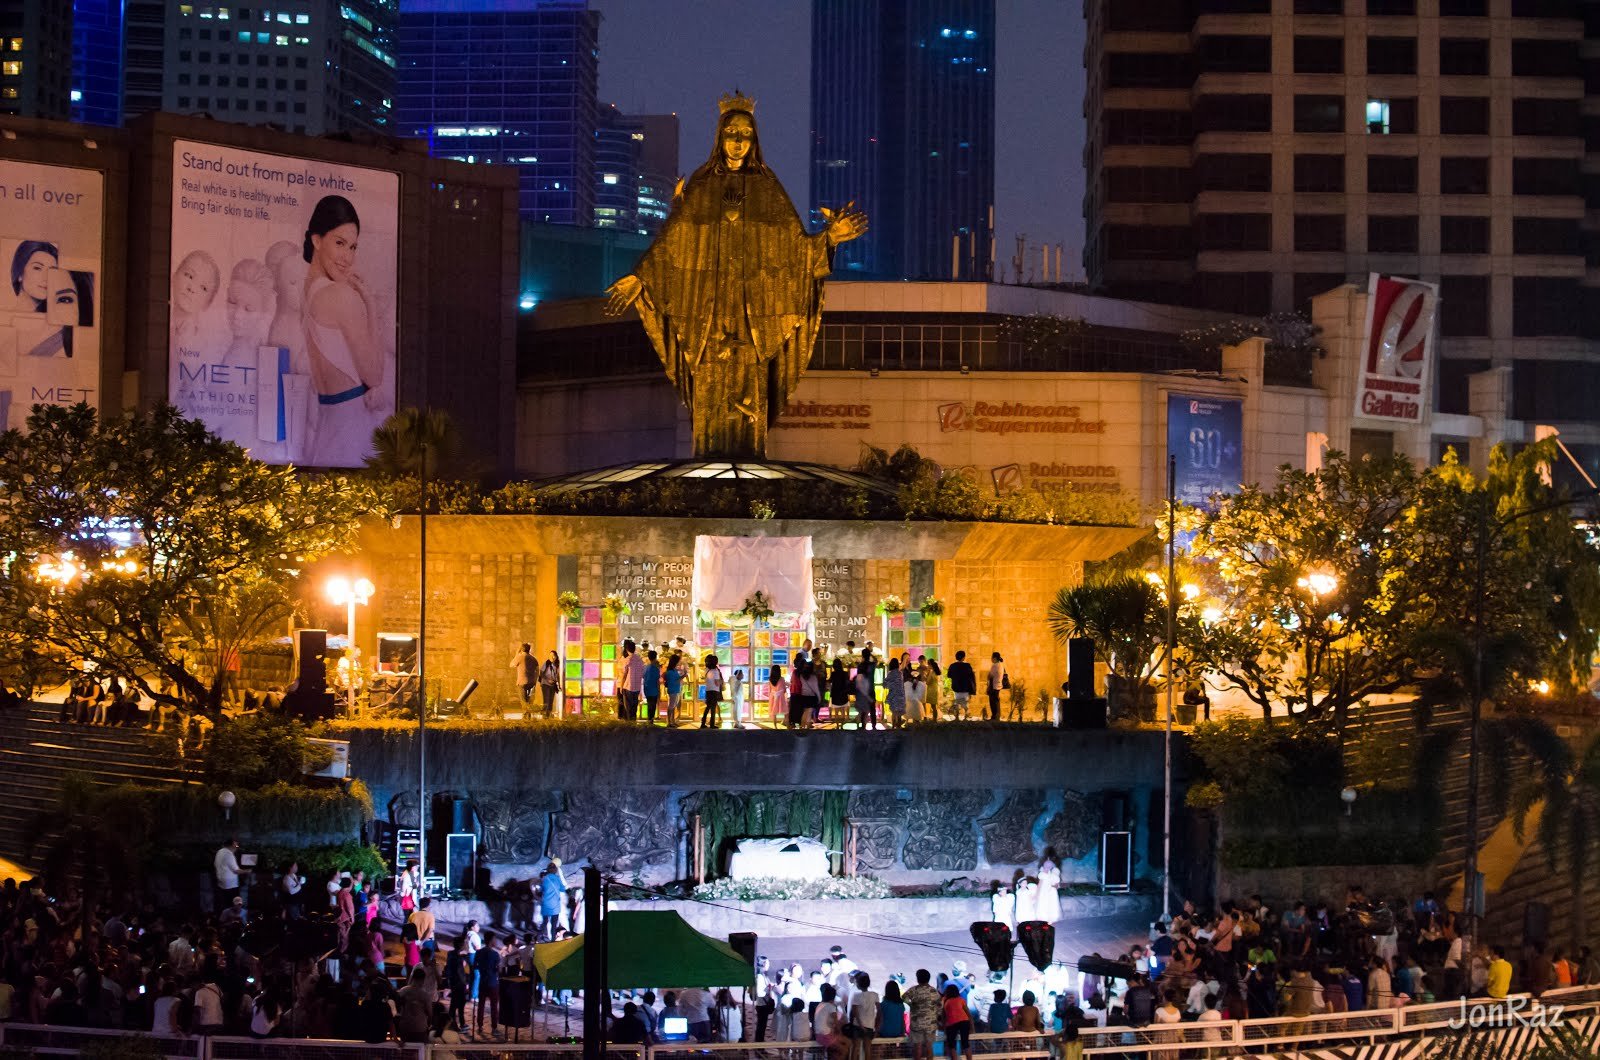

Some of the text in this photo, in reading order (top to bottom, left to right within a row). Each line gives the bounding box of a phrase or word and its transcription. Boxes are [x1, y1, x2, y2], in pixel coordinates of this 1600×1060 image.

[182, 152, 357, 192] Stand out from pale white.
[15, 184, 35, 200] all
[43, 190, 83, 205] over
[181, 178, 299, 207] Real white is healthy white.
[181, 197, 270, 220] Bring fair skin to life.
[180, 347, 200, 358] New
[180, 362, 256, 384] MET
[32, 387, 95, 402] MET
[179, 390, 256, 404] TATHIONE
[785, 400, 871, 417] obinsons
[973, 402, 1080, 417] Robinsons
[1362, 391, 1419, 419] Galleria
[975, 418, 1106, 435] Supermarket
[1030, 463, 1116, 477] Robinsons
[642, 563, 658, 571] MY
[664, 563, 694, 572] PEOPL
[616, 576, 656, 585] HUMBLE
[663, 576, 692, 585] THEM
[666, 589, 687, 598] AND
[626, 602, 645, 611] AYS
[650, 602, 677, 611] THEN
[827, 604, 848, 613] AND
[644, 615, 689, 624] FORGIVE
[815, 617, 837, 626] HEIR
[848, 629, 867, 638] 7:14
